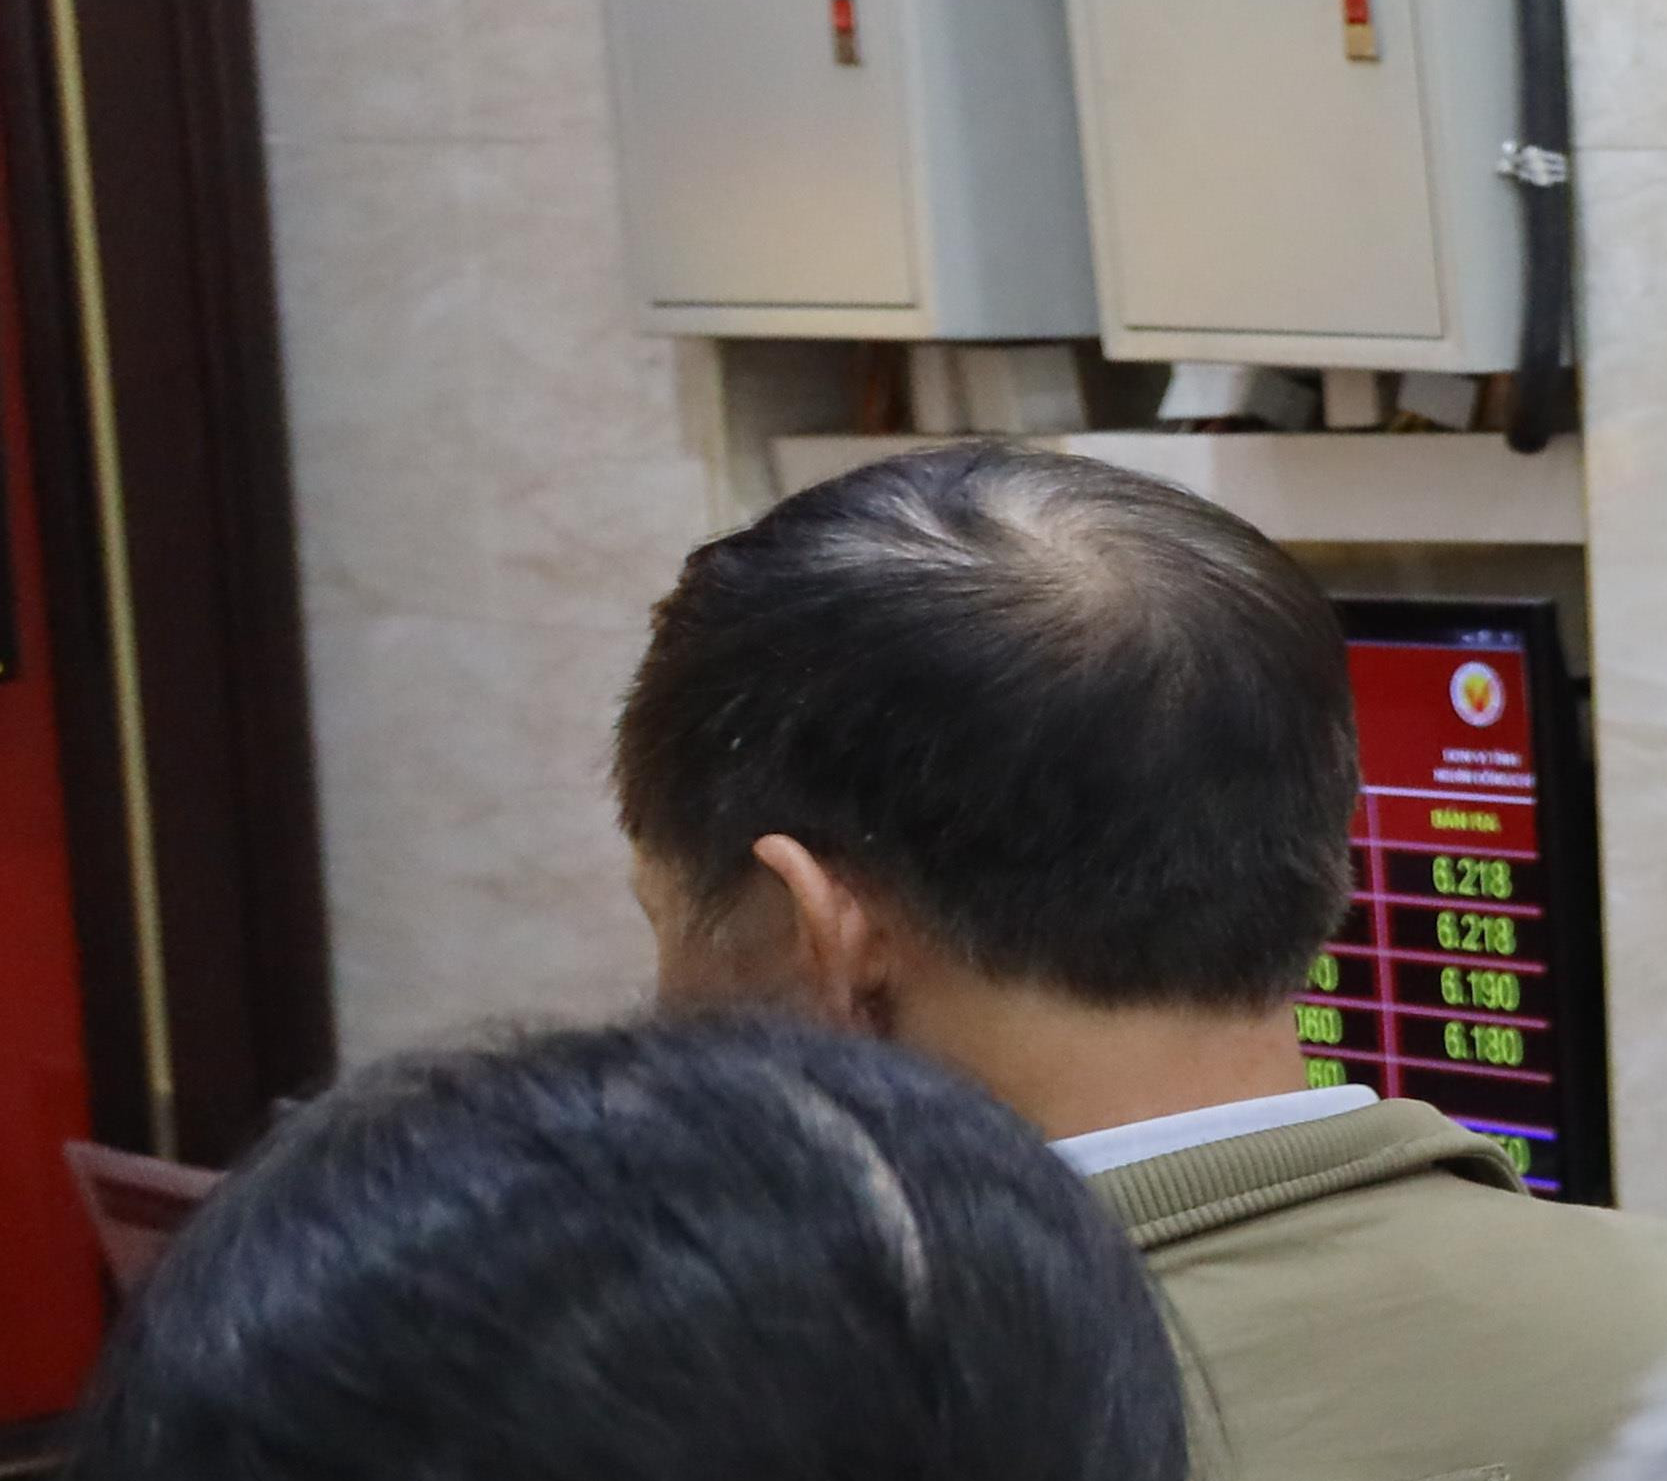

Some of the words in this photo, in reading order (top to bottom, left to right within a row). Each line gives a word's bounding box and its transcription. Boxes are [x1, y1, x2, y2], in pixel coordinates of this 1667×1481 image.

[1432, 855, 1514, 900] 6.218
[1436, 910, 1517, 956] 6.218
[1440, 966, 1521, 1012] 6.190
